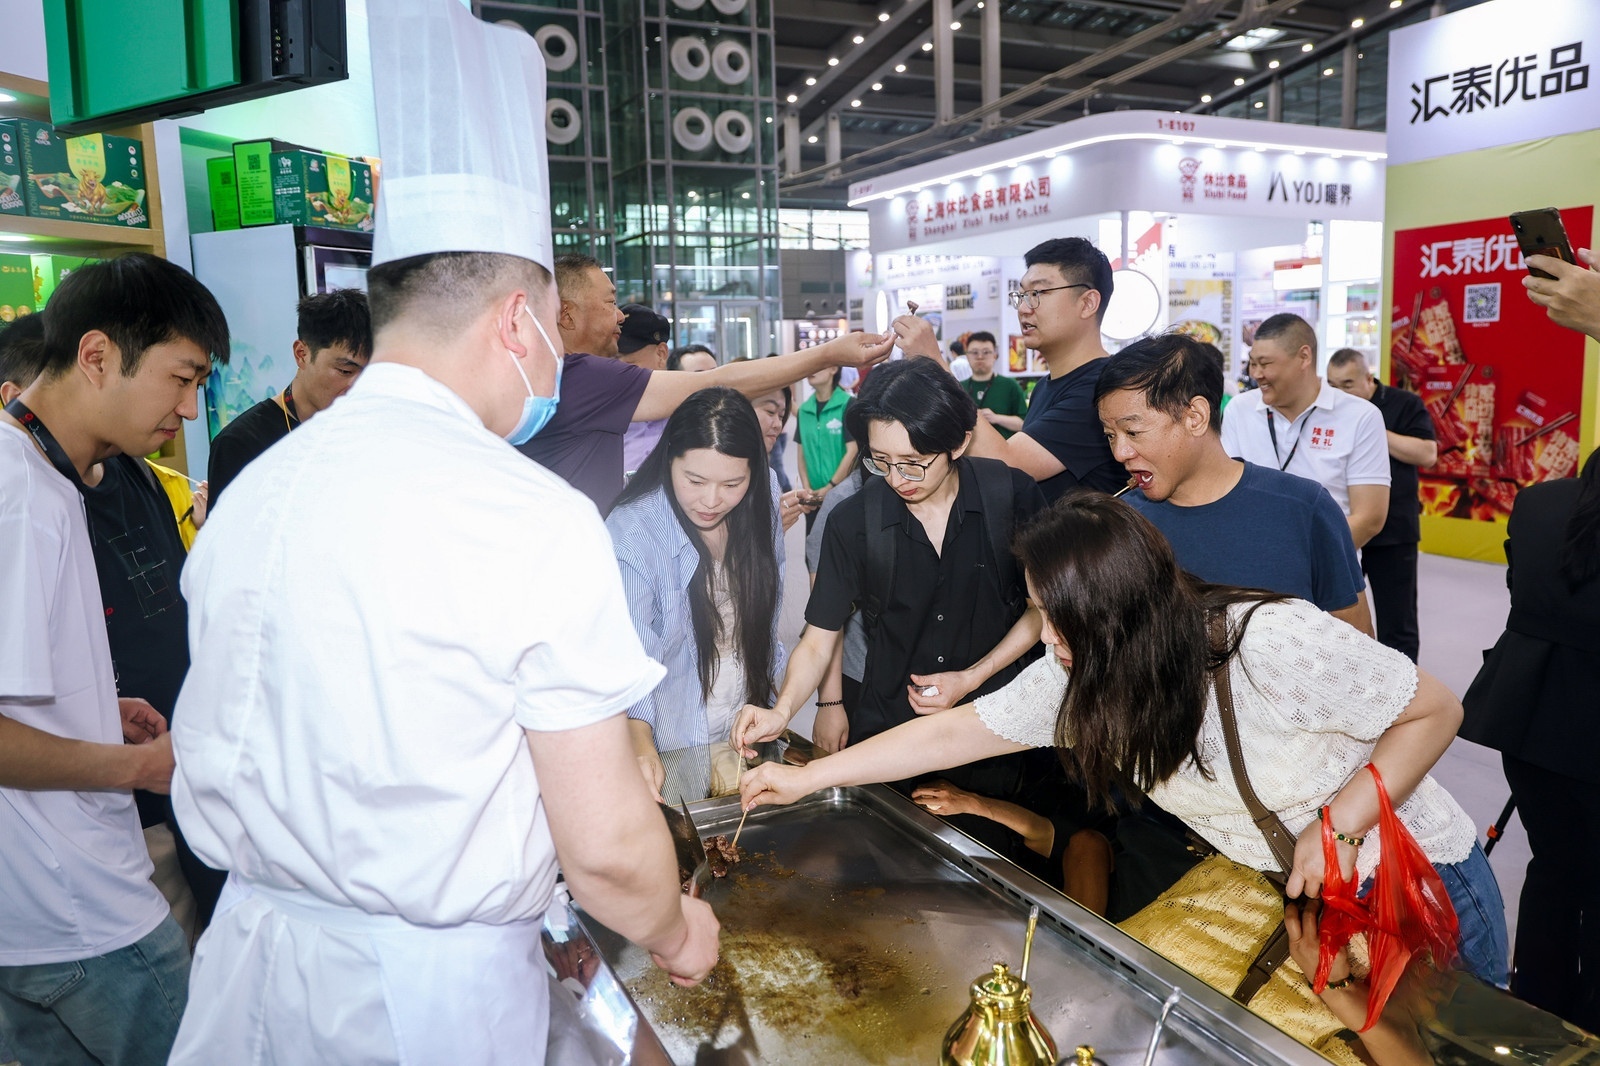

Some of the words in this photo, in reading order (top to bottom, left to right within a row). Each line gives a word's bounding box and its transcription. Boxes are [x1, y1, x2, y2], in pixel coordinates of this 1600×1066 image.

[1410, 41, 1590, 125] 汇泰优品
[1157, 118, 1195, 132] 1-E107
[924, 223, 957, 236] Shanghai
[990, 211, 1010, 223] Food
[1419, 234, 1529, 279] 汇泰优
